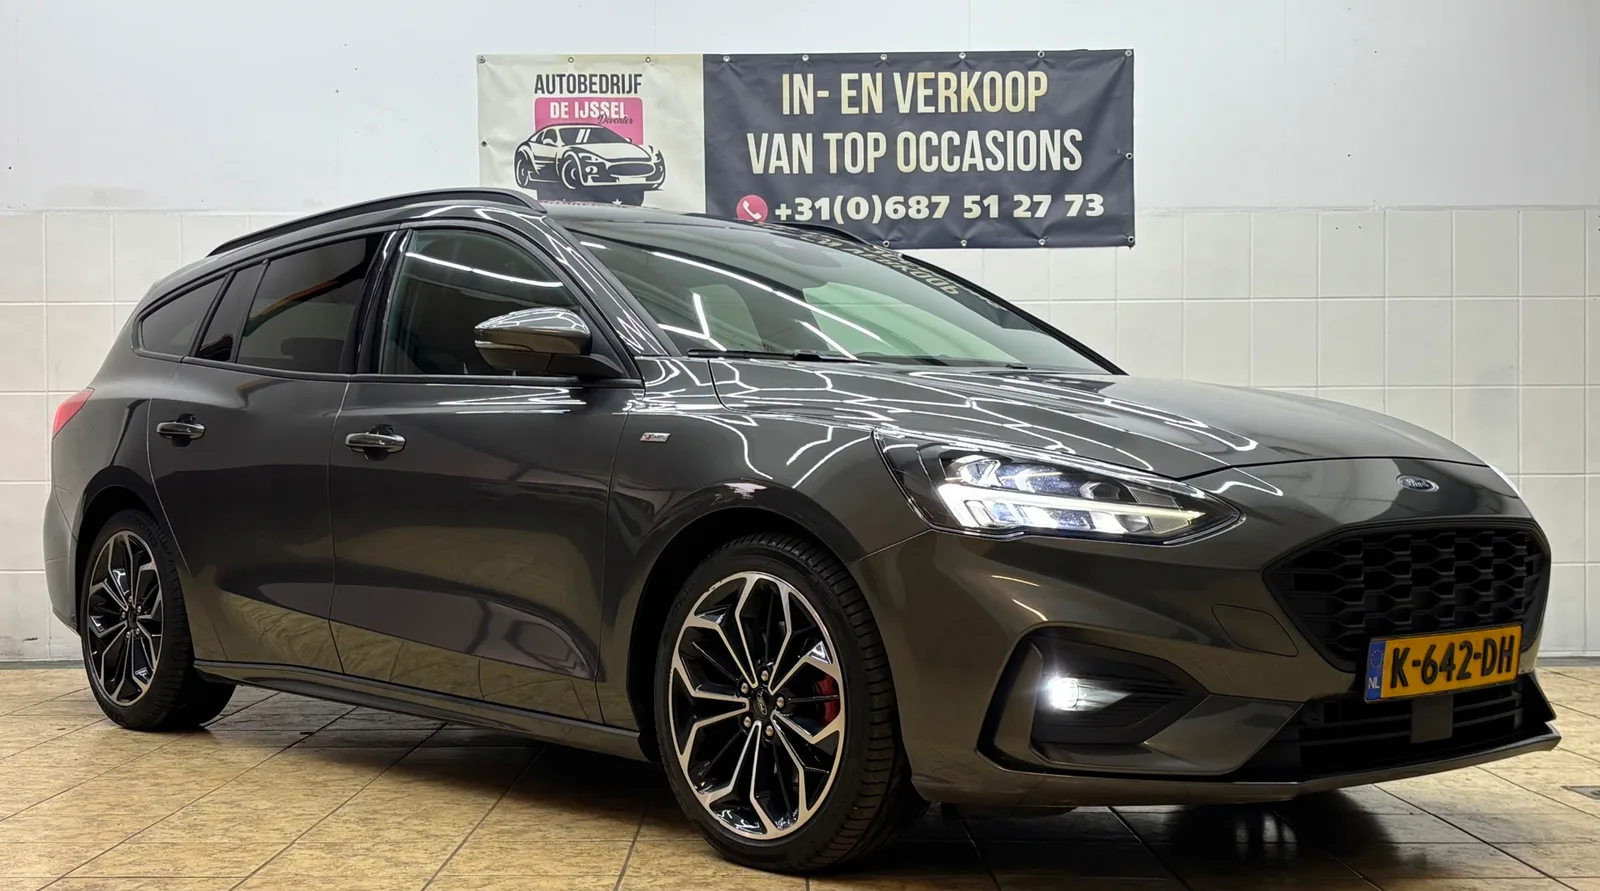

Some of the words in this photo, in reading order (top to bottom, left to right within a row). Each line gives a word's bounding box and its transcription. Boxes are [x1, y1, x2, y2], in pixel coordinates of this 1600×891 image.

[534, 73, 643, 95] AUTOBEDRIJF
[782, 73, 830, 115] IN-
[841, 72, 883, 115] EN
[893, 71, 1048, 114] VERKOOP
[549, 102, 569, 119] DE
[574, 101, 629, 119] IJSSEL
[746, 132, 813, 175] VAN
[823, 131, 887, 174] TOP
[897, 128, 1083, 173] OCCASIONS
[774, 194, 950, 225] +31(0)687
[963, 194, 999, 219] 51
[1013, 193, 1052, 218] 27
[1064, 193, 1104, 217] 73
[1390, 635, 1516, 689] K-642-DH
[1368, 676, 1380, 689] NL
